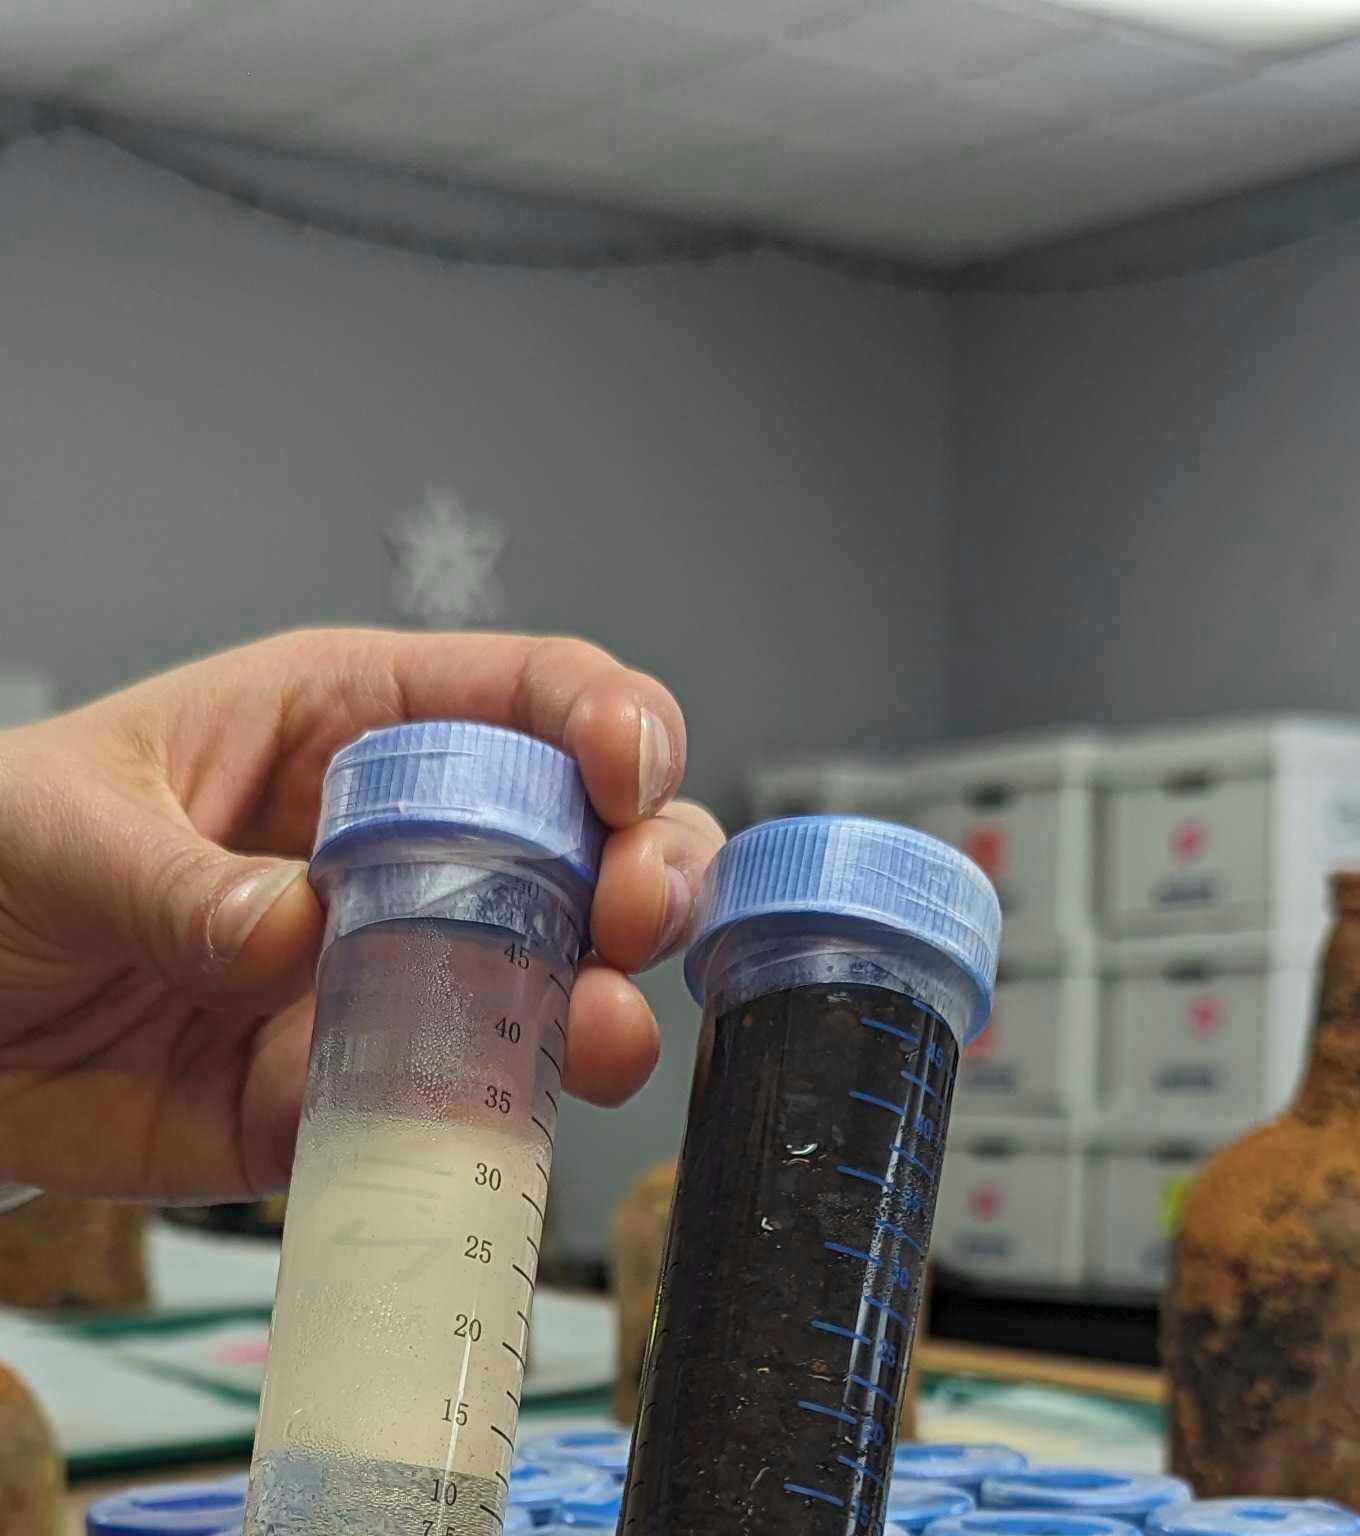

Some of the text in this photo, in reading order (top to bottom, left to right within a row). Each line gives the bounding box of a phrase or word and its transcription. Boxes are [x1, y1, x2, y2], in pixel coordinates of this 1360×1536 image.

[504, 943, 529, 970] 45
[495, 1017, 521, 1043] 40
[485, 1085, 511, 1114] 35
[475, 1162, 502, 1191] 30
[464, 1235, 492, 1263] 25
[454, 1313, 482, 1342] 20
[441, 1398, 469, 1426] 15
[431, 1479, 457, 1506] 10
